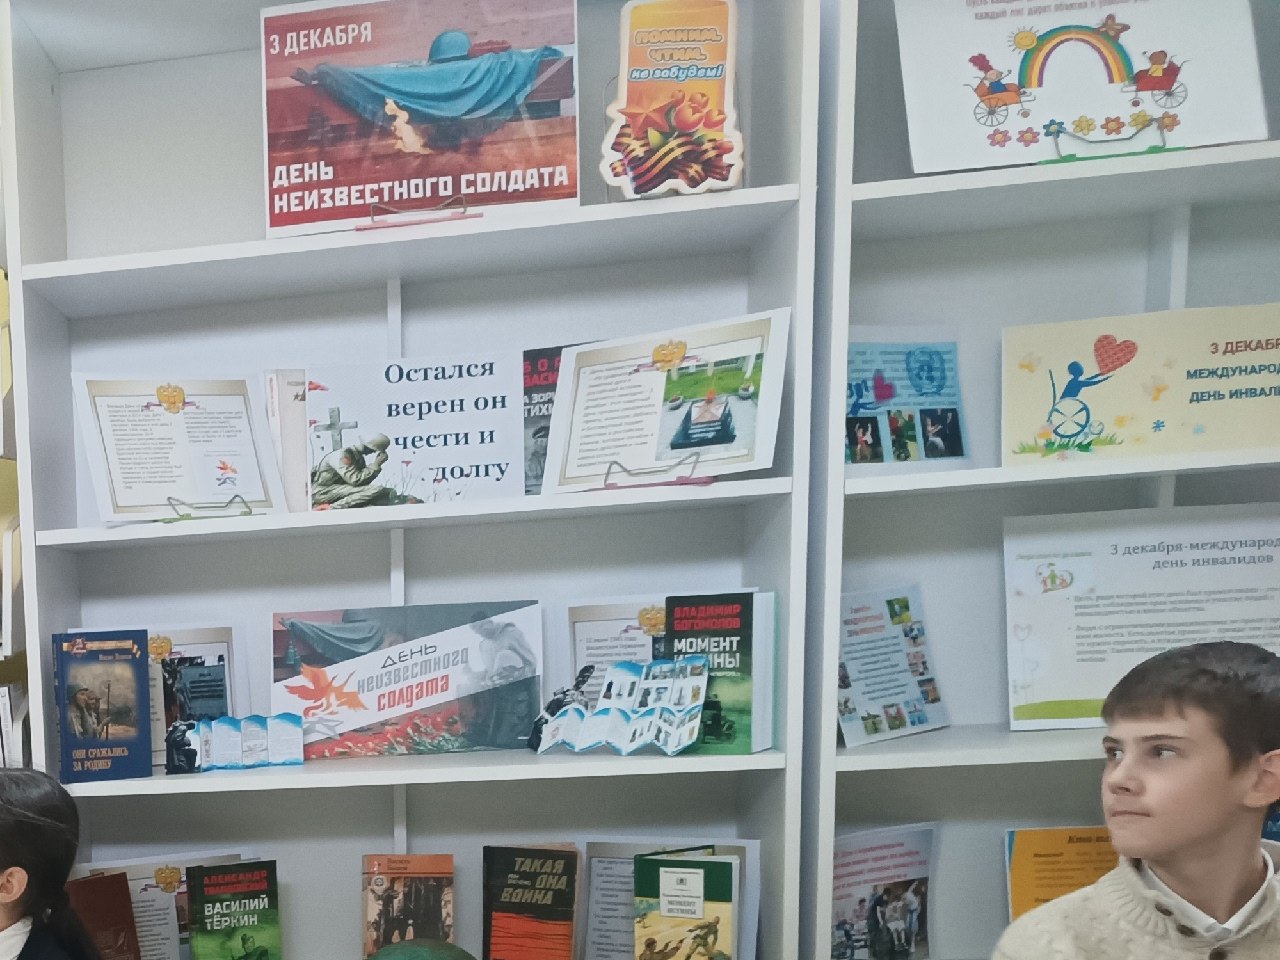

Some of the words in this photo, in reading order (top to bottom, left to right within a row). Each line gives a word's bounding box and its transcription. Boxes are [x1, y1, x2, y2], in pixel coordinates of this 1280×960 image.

[269, 35, 280, 56] 3
[284, 21, 373, 58] ДЕКАБРЯ
[272, 160, 334, 189] ДЕНЬ
[274, 175, 453, 213] НЕИЗВЕСТНОГО
[460, 165, 569, 195] СОЛДАТА
[1210, 342, 1219, 354] 3
[384, 361, 496, 384] Остался
[386, 397, 465, 420] верен
[474, 394, 508, 411] он
[1189, 390, 1226, 404] ДЕНЬ
[394, 432, 470, 451] чести
[479, 429, 496, 445] и
[433, 463, 510, 482] долгу
[1110, 544, 1118, 555] 3
[1152, 558, 1187, 570] день
[1192, 553, 1274, 567] инвалидов
[673, 636, 741, 653] МОМЕНТ
[380, 643, 438, 669] ДЕНЬ
[515, 857, 565, 874] ТАКАЯ
[204, 894, 269, 915] ВАСИЛИЙ
[205, 914, 258, 931] ТЁРКИН
